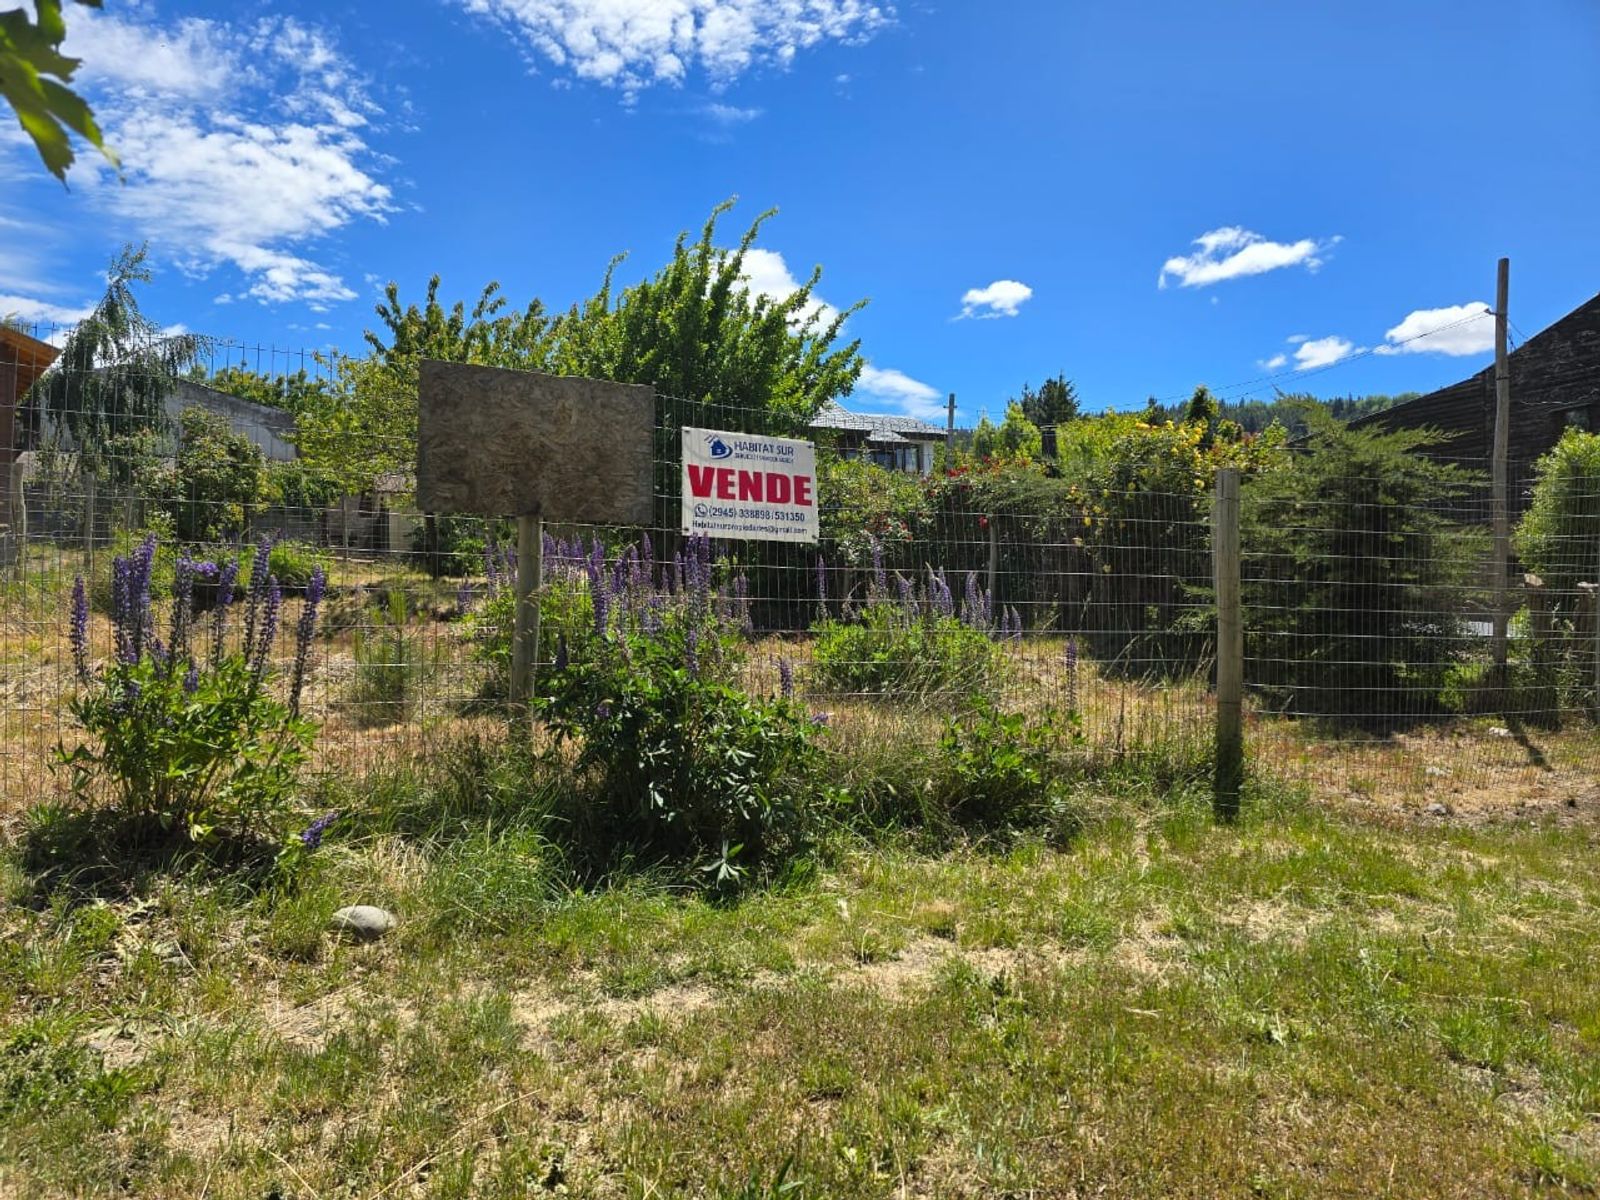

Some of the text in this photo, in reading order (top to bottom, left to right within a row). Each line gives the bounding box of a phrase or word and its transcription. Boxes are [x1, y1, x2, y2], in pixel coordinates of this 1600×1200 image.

[733, 441, 794, 456] HABITAT SUR
[687, 464, 812, 506] VENDE
[708, 505, 737, 518] (2945)
